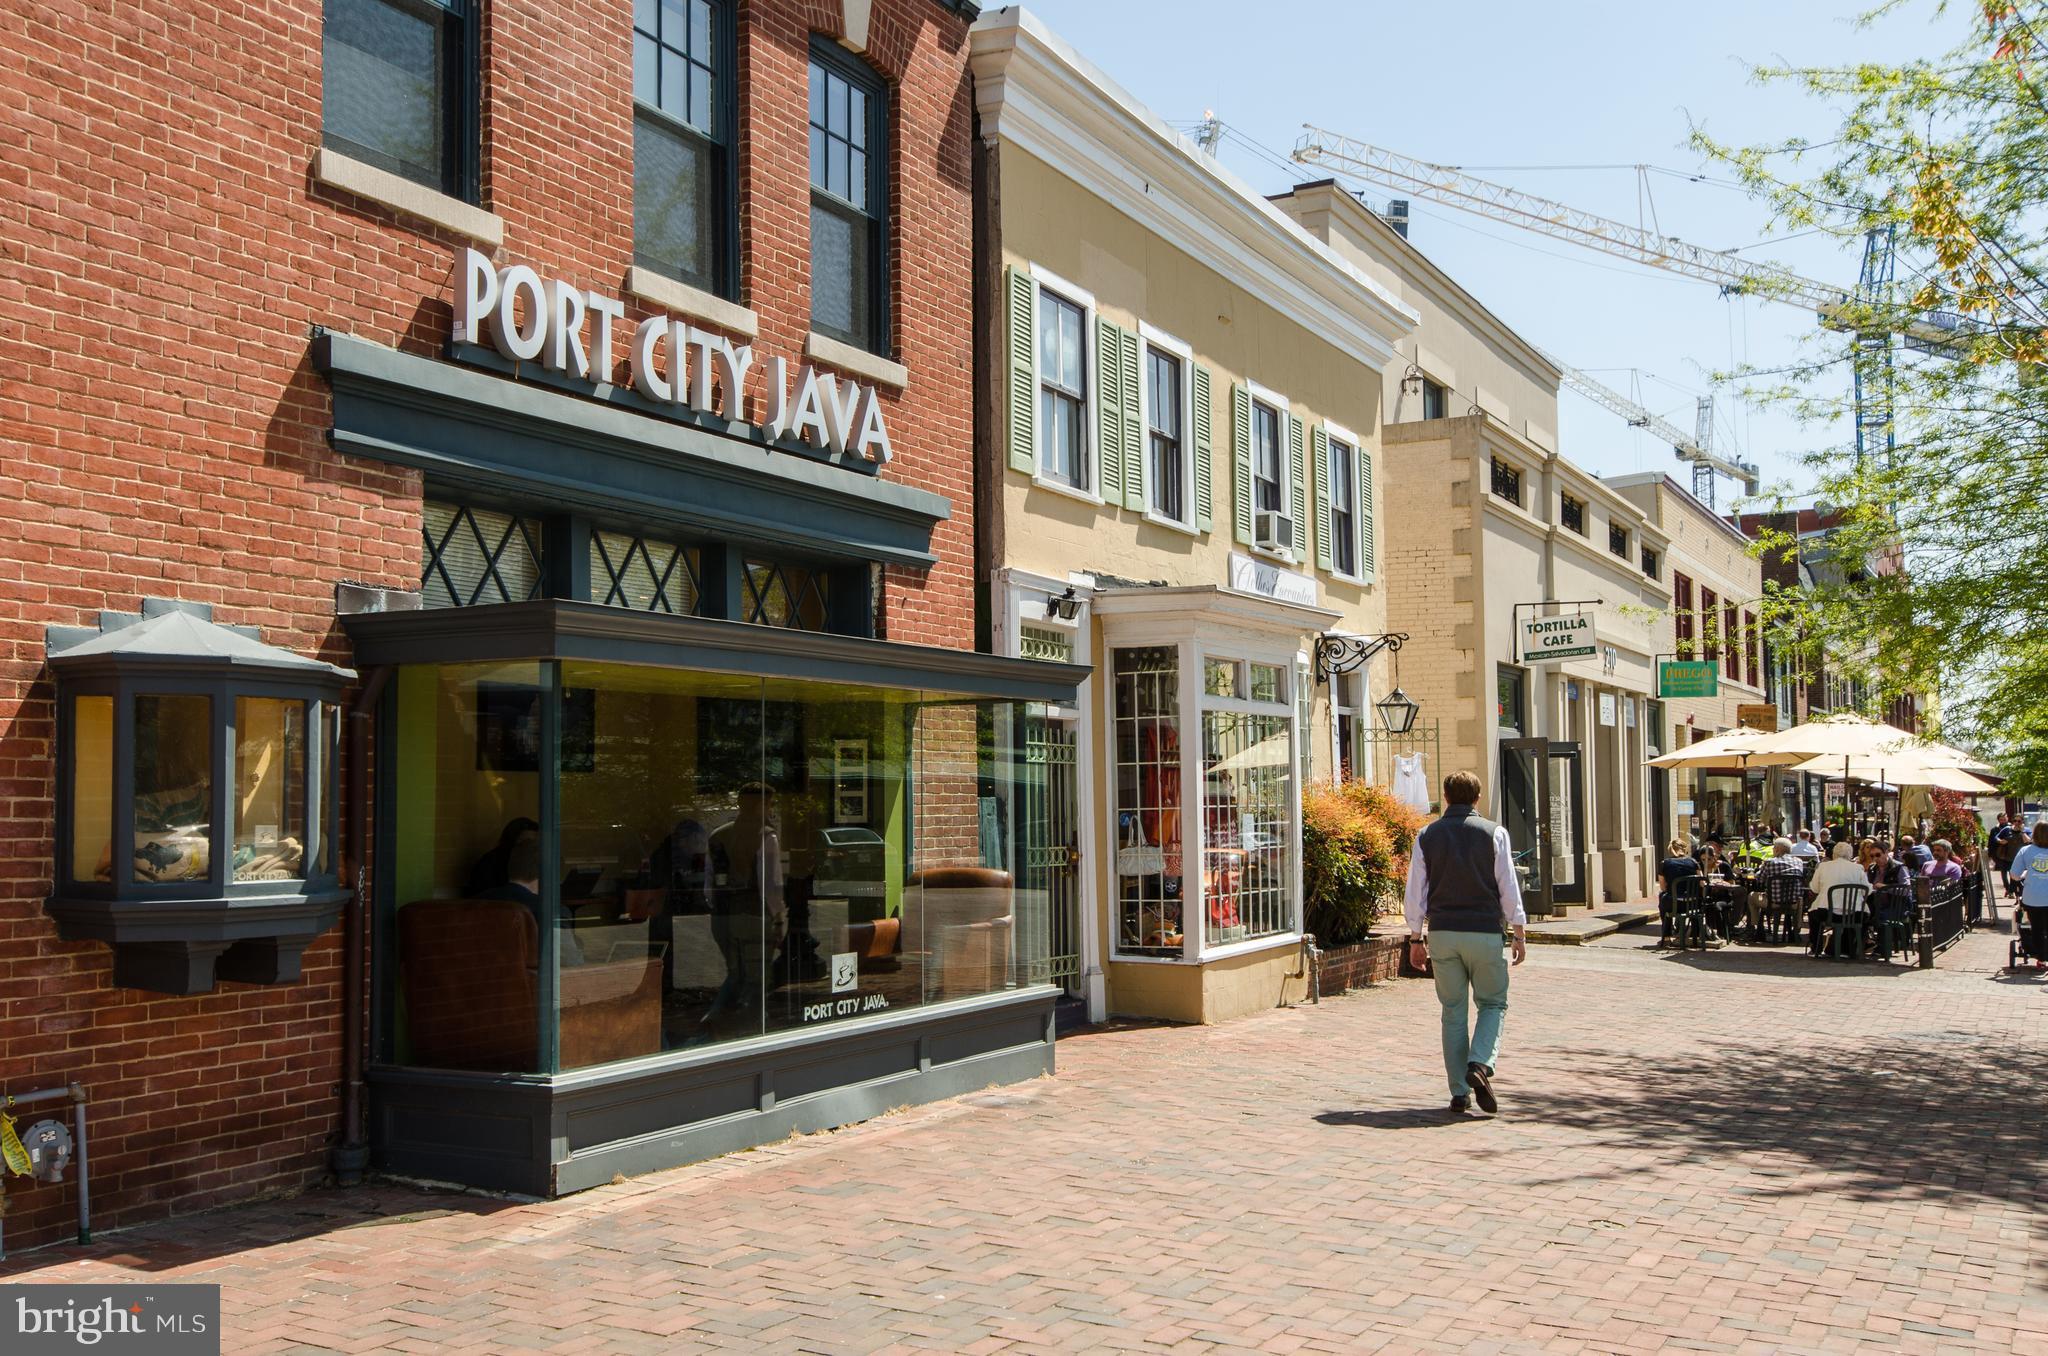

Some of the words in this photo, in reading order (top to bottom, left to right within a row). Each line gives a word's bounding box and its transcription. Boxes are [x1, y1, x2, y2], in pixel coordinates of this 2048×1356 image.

[453, 247, 625, 384] PORT
[630, 315, 753, 422] CITY
[763, 355, 893, 464] JAVA
[1527, 618, 1588, 634] TORTILLA
[1543, 634, 1574, 647] CAFE
[1604, 646, 1617, 669] 210
[804, 1002, 834, 1022] PORT
[836, 998, 860, 1016] CITY
